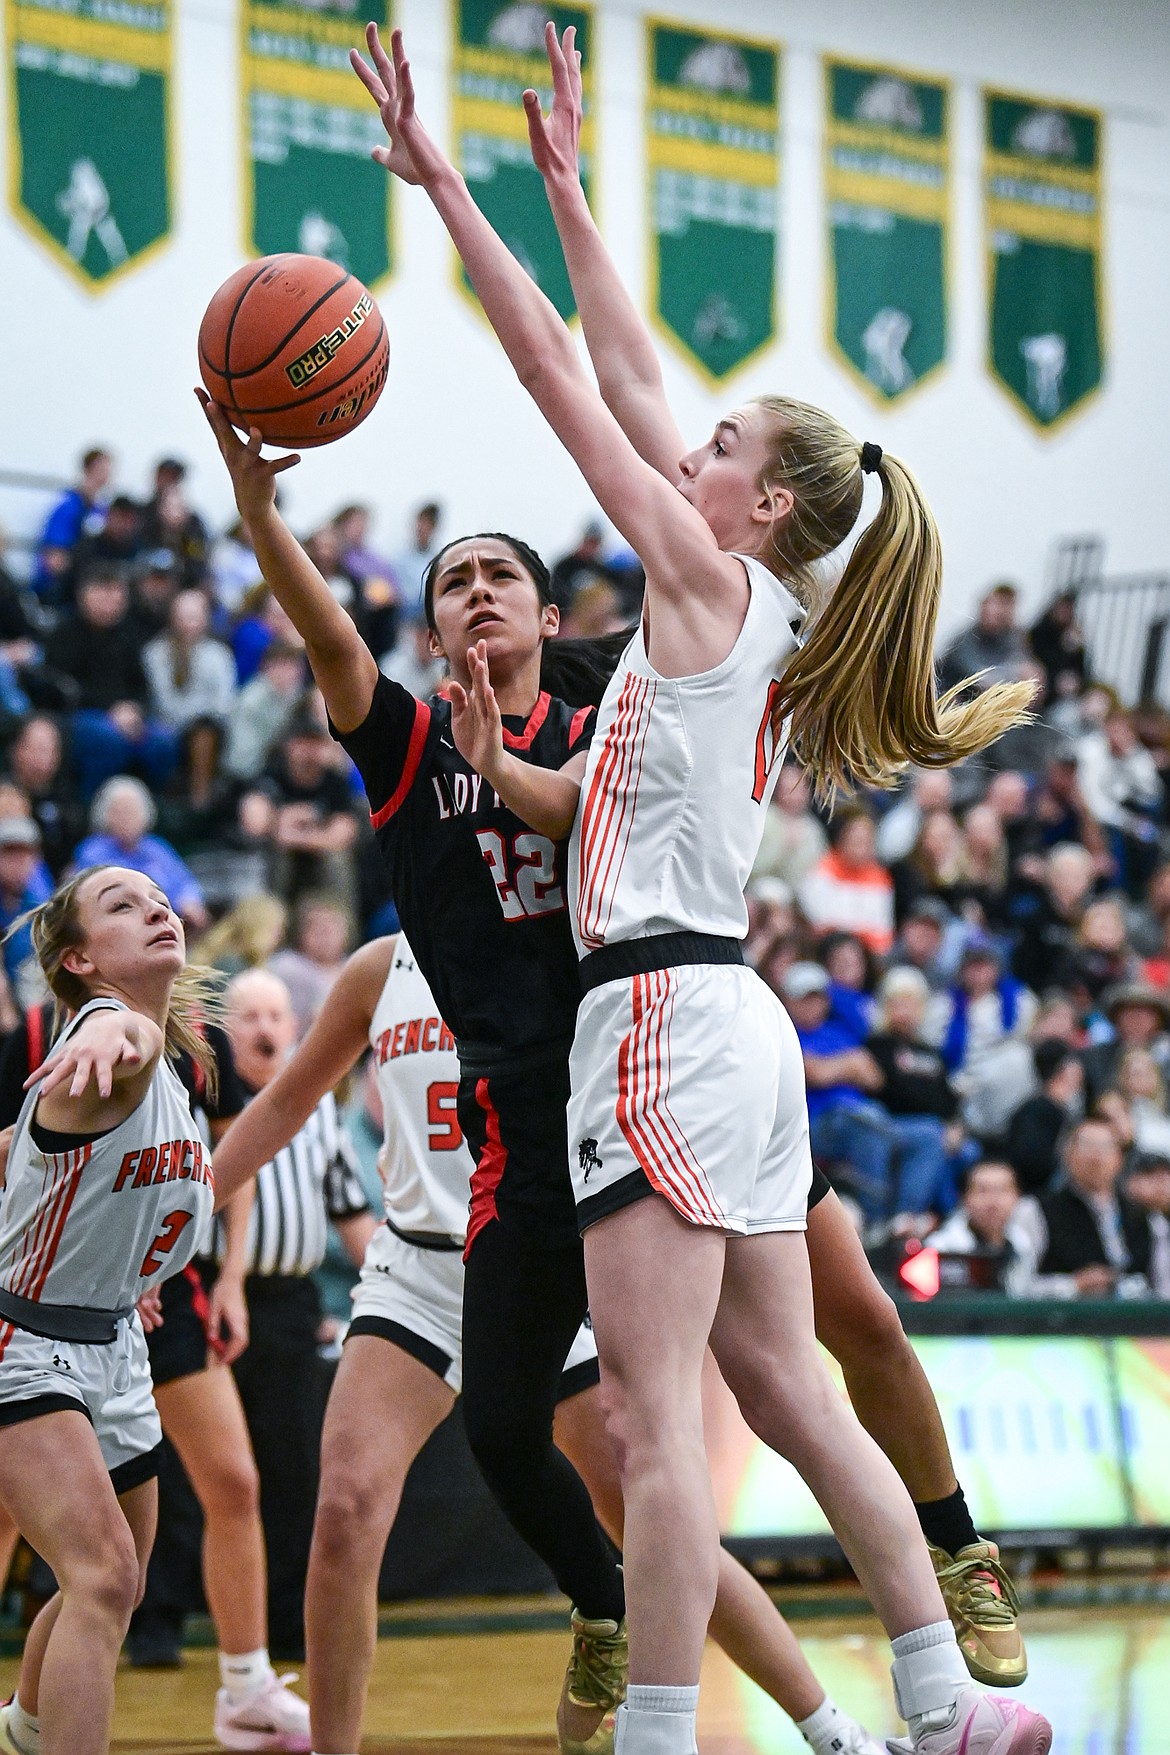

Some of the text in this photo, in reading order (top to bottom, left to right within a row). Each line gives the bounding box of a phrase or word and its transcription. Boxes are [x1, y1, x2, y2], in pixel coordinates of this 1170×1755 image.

[322, 291, 374, 356] ELITE
[288, 342, 330, 384] PRO
[432, 772, 482, 820] LDY
[475, 827, 567, 922] 22
[427, 1081, 463, 1151] 5
[139, 1209, 194, 1277] 2
